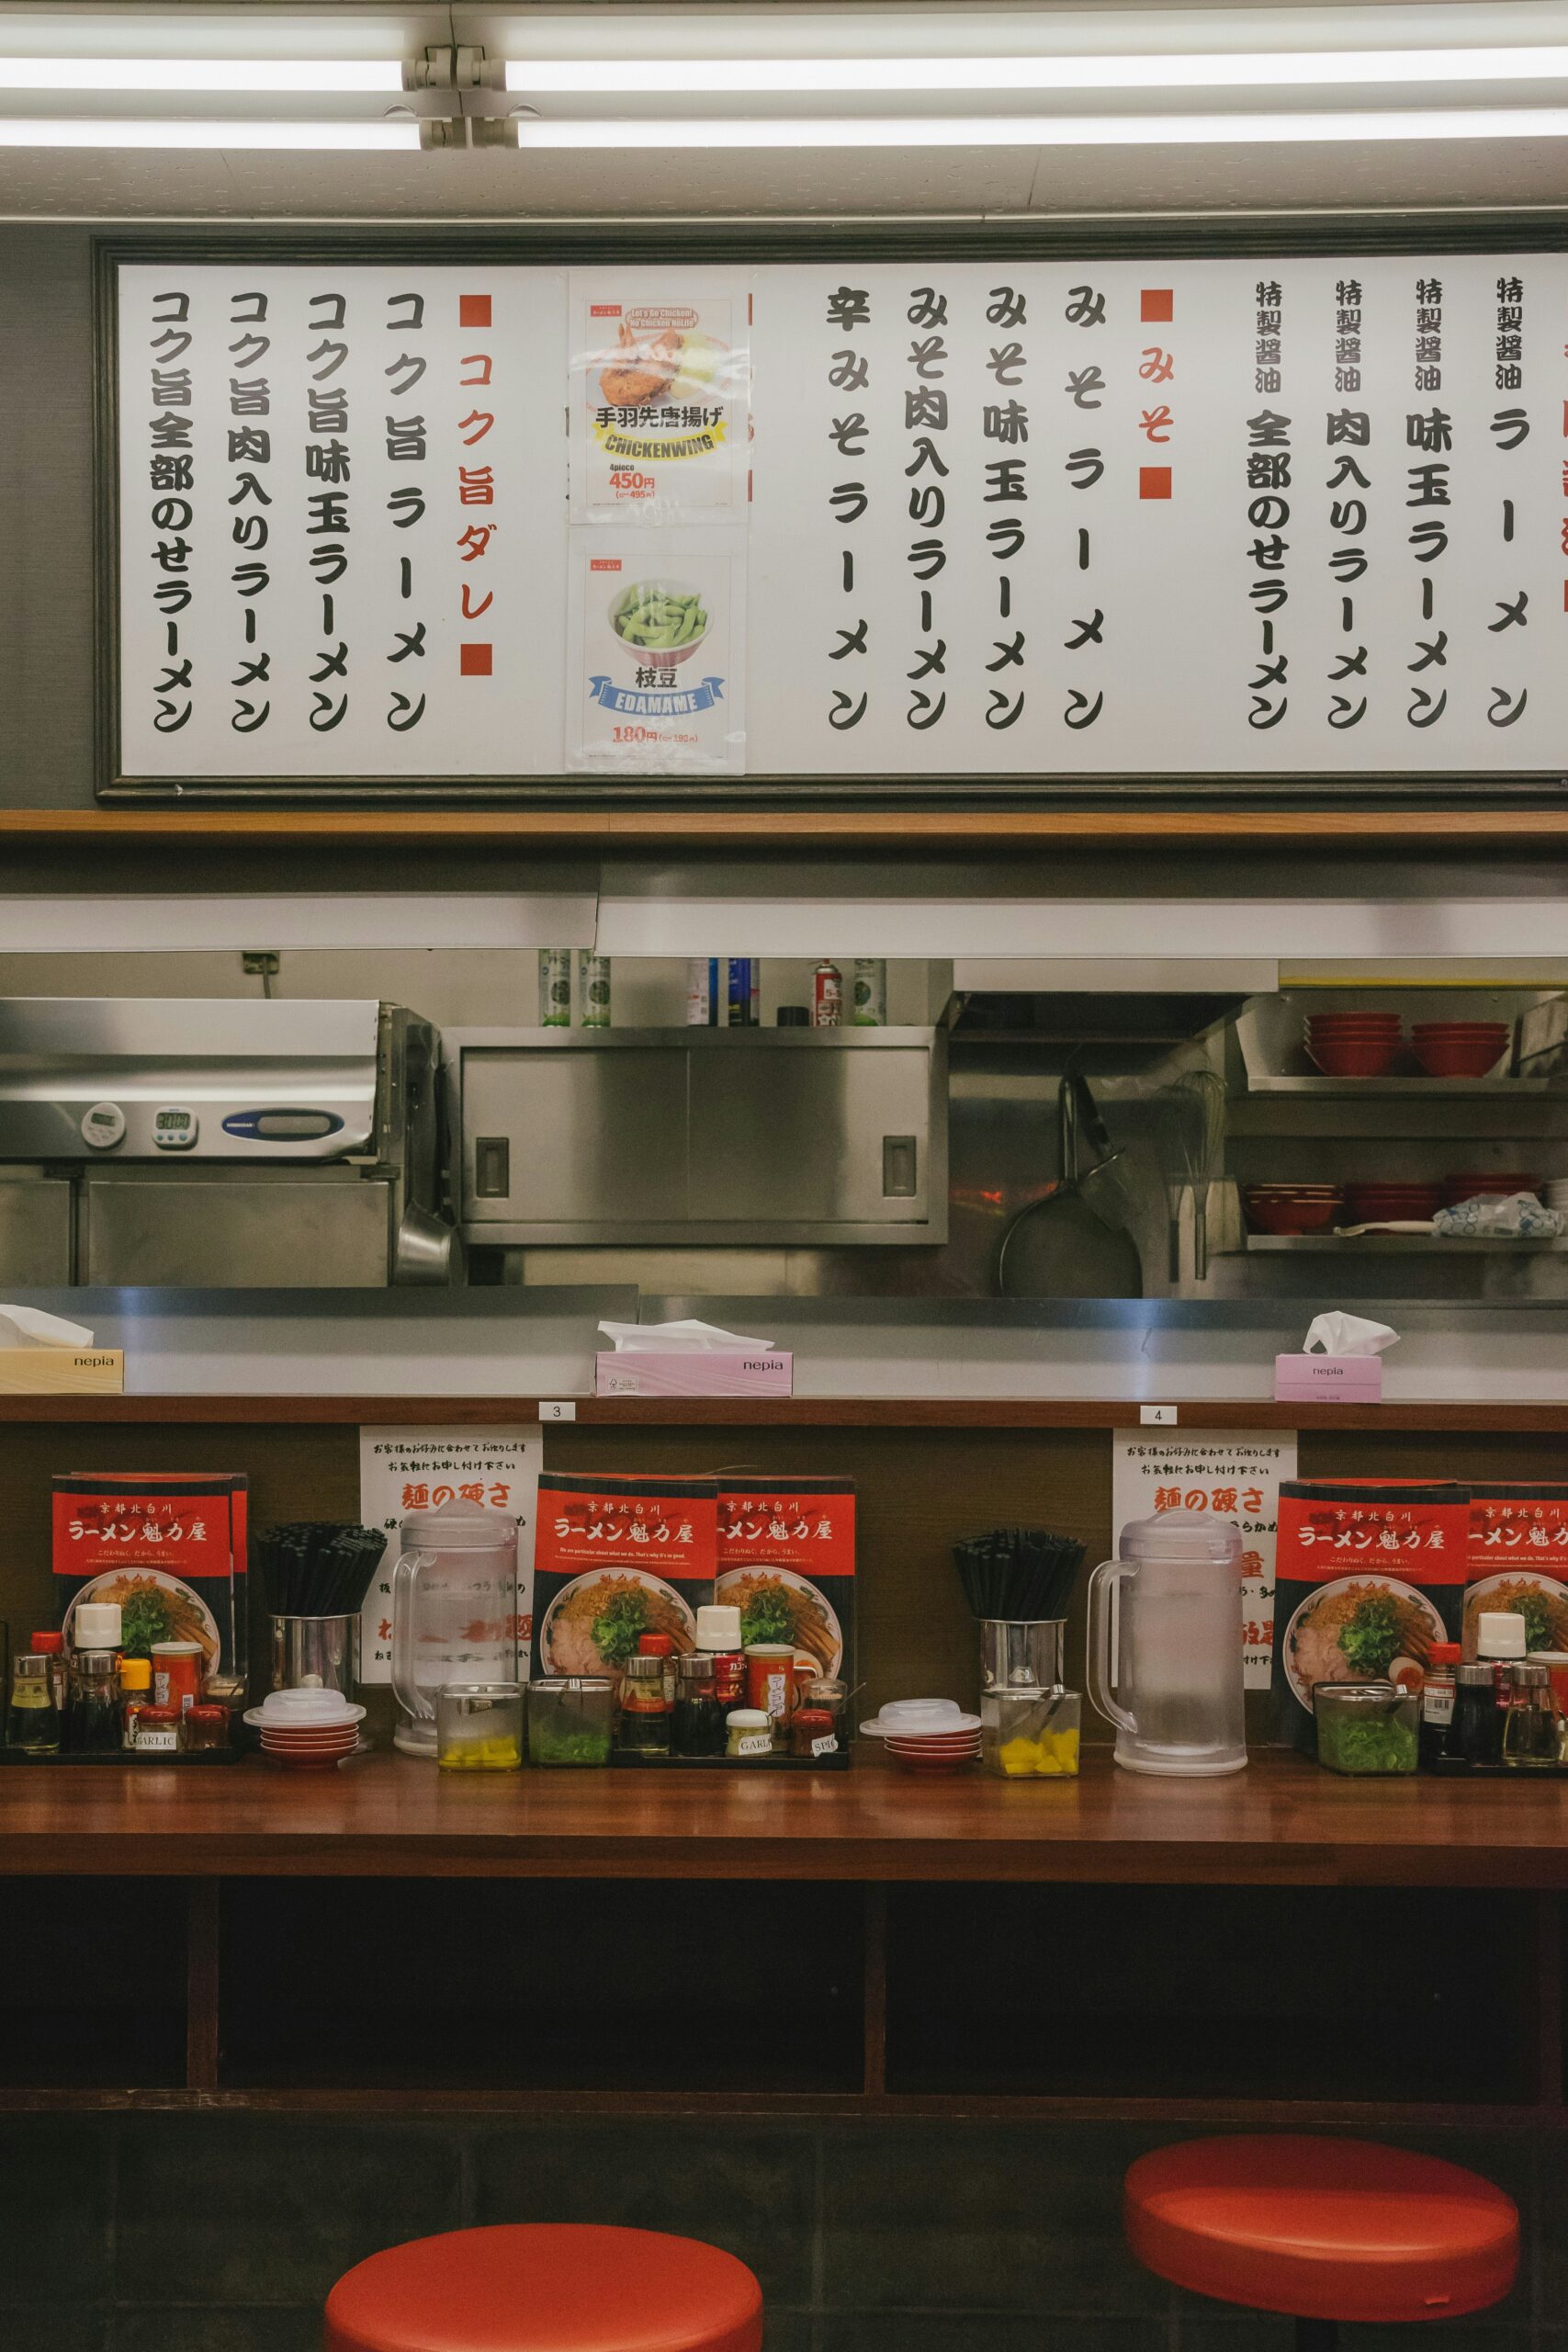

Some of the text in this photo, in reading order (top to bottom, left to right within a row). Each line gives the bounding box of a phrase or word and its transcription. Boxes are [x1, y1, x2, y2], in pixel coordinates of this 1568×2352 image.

[1139, 347, 1174, 444] みそ
[596, 406, 724, 428] 手羽先唐揚げ
[604, 434, 715, 458] CHICKENWING
[457, 355, 497, 619] コク旨ダレ
[609, 472, 655, 489] 450円
[150, 292, 194, 733] コク旨全部のせラーメン
[228, 292, 272, 732] コク旨肉入りラーメン
[306, 294, 350, 731] コク旨味玉ラーメン
[384, 293, 427, 731] コク旨ラーメン
[827, 287, 870, 730] 辛みそラーメン
[905, 288, 949, 729] みそ肉入りラーメン
[984, 287, 1028, 729] みそ味玉ラーメン
[1064, 286, 1105, 729] みそラーメン
[1247, 280, 1292, 729] 特製醤油 全部のせラーメン
[1326, 279, 1371, 729] 特製醤油 肉入りラーメン
[1406, 277, 1452, 729] 特製醤油 味玉ラーメン
[1487, 277, 1530, 727] 特製醤油 ラーメン
[636, 667, 678, 688] 枝豆
[615, 691, 698, 715] EDAMAME
[613, 726, 658, 742] 180円
[74, 1356, 114, 1367] nepia
[743, 1360, 784, 1371] nepia
[1313, 1366, 1344, 1375] nepia
[553, 1406, 561, 1418] 3
[1155, 1410, 1163, 1420] 4
[1141, 1464, 1269, 1476] お気軽にお申し付け下さい
[100, 1502, 172, 1515] 京都北白川
[588, 1500, 660, 1515] 京都北白川
[727, 1500, 799, 1513] 京都北白川
[1154, 1487, 1265, 1513] 麺の硬さ
[1335, 1510, 1412, 1521] 京都北白川
[1485, 1507, 1560, 1519] 京都北白川
[68, 1521, 208, 1543] ラーメン魁力屋
[554, 1518, 694, 1544] ラーメン魁力屋
[716, 1521, 833, 1541] ーメン魁力屋
[1298, 1526, 1445, 1550] ラーメン魁力屋
